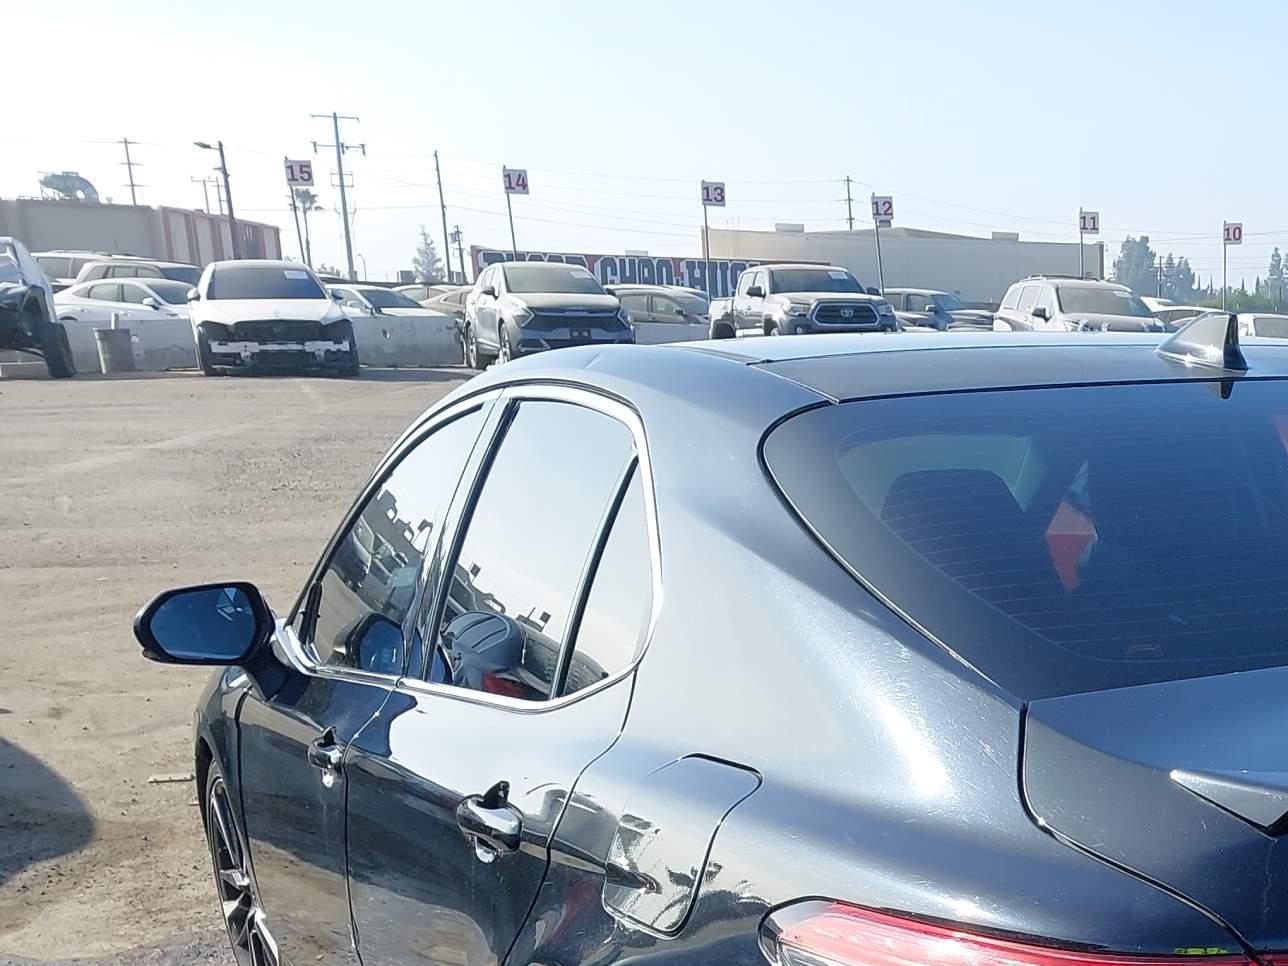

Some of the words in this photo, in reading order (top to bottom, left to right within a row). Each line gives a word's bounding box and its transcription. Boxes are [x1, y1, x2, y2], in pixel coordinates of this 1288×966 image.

[287, 164, 312, 182] 15
[504, 173, 528, 191] 14
[703, 186, 725, 203] 13
[873, 201, 893, 216] 12
[1080, 215, 1099, 231] 11
[1224, 226, 1242, 241] 10
